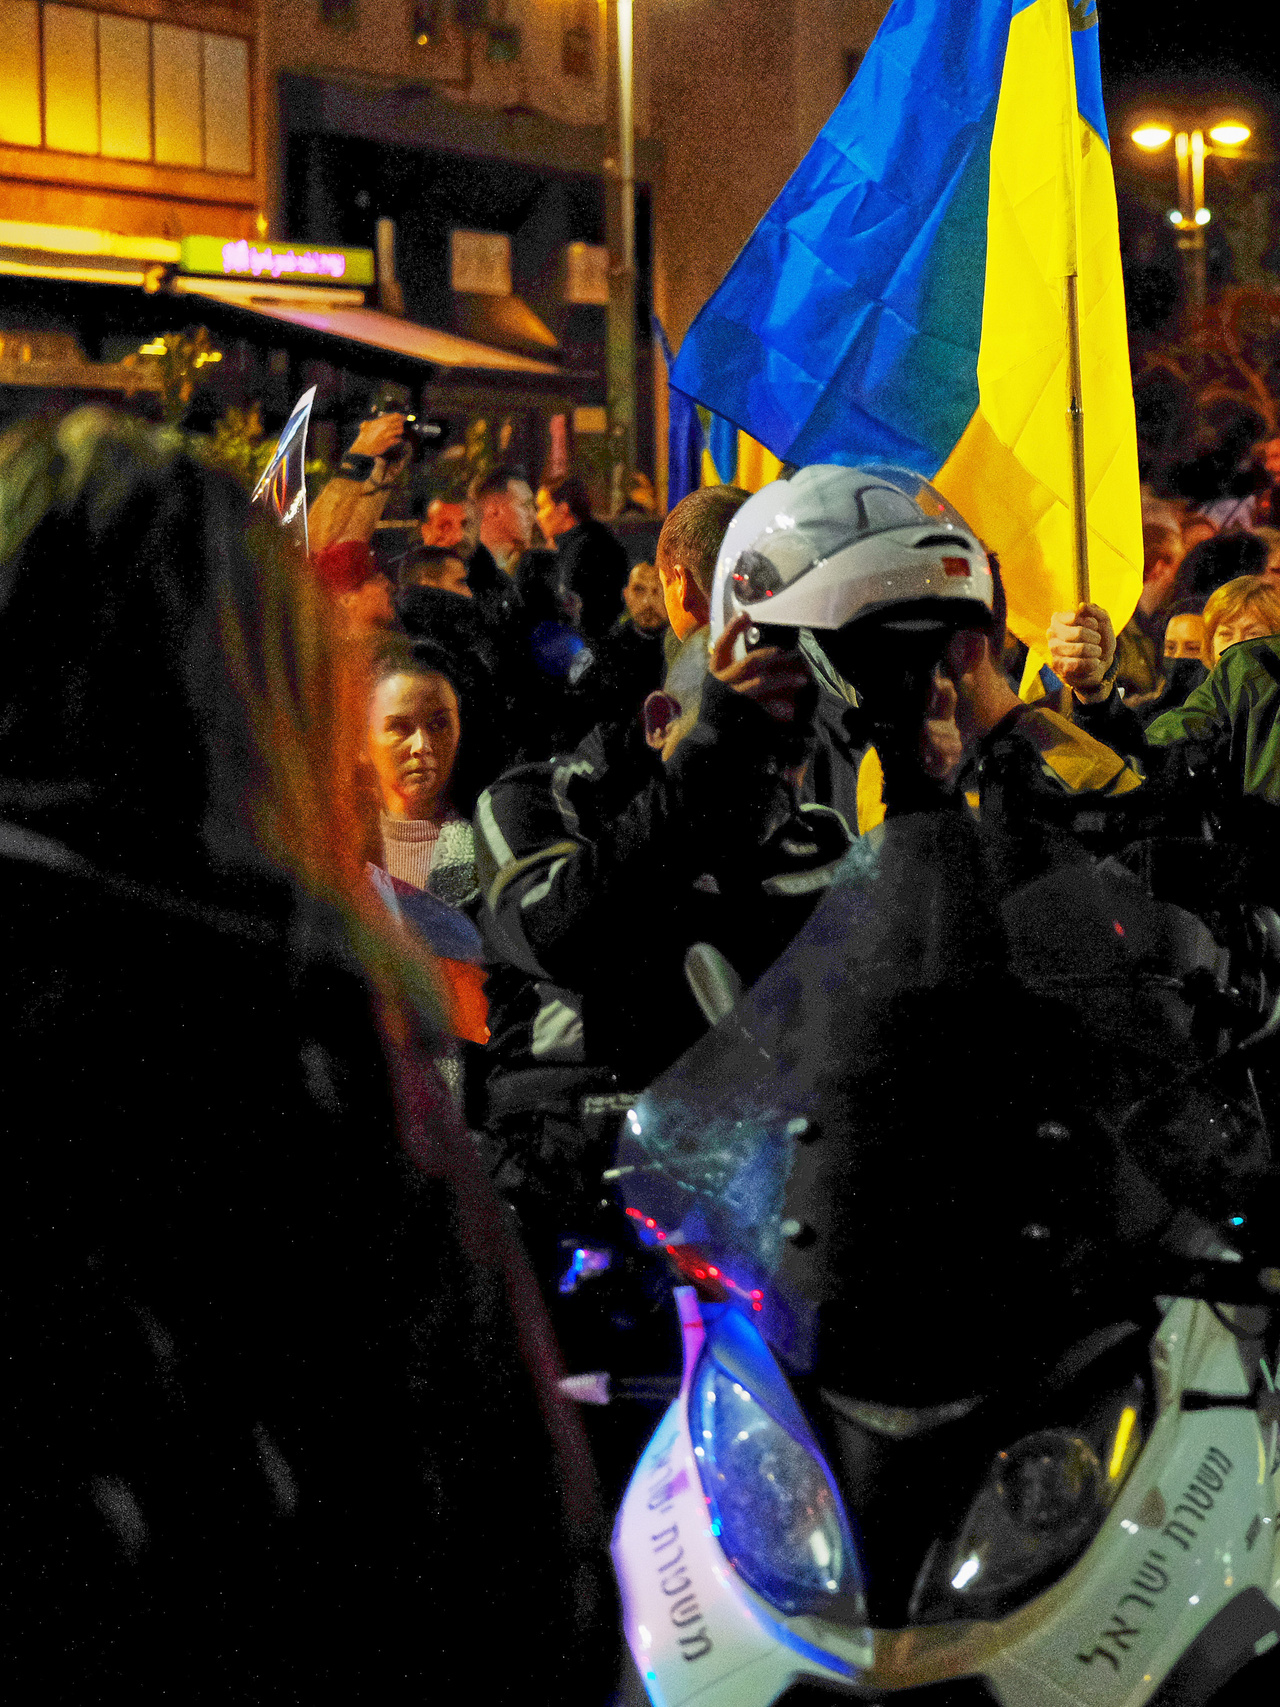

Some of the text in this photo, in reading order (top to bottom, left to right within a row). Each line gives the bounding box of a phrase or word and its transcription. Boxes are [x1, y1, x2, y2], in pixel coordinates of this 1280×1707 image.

[651, 1522, 714, 1663] משטרת
[1075, 1446, 1234, 1671] משטרת ישראל
